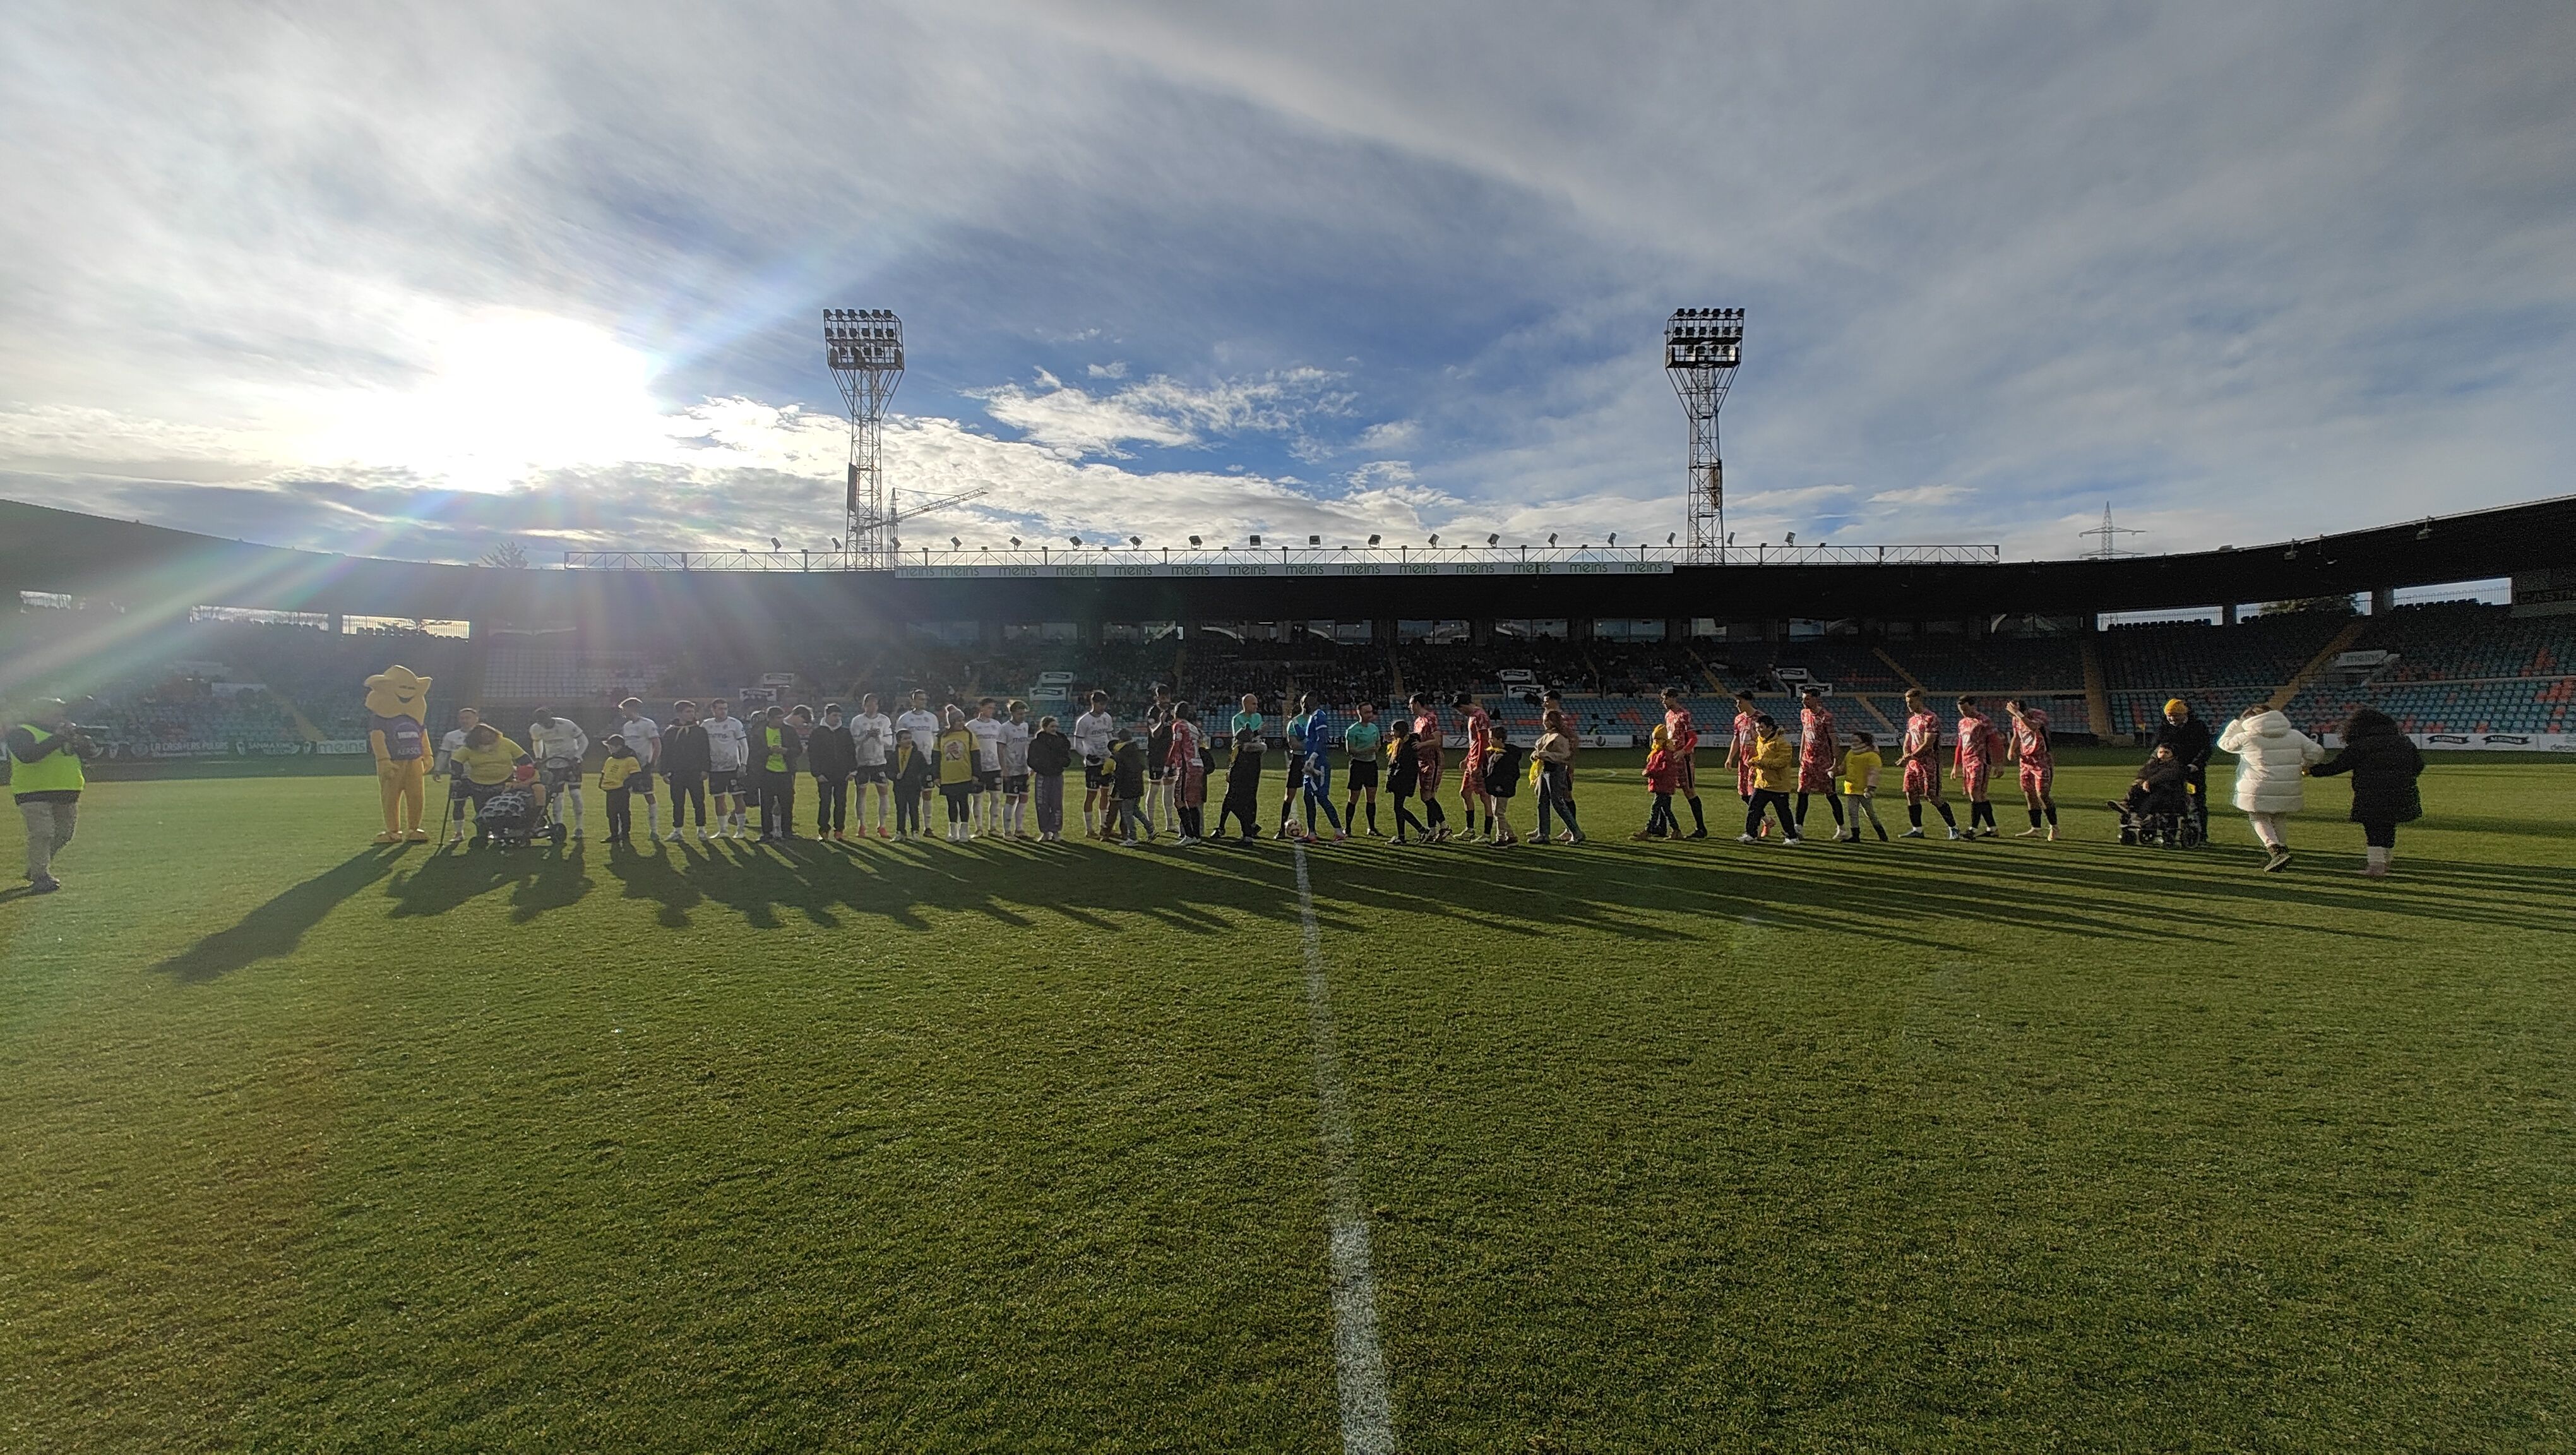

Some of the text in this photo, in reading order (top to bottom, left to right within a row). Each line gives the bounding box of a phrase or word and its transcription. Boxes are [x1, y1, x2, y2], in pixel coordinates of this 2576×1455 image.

[897, 567, 934, 577] meins
[941, 566, 979, 576] meins
[999, 566, 1037, 576] meins
[1056, 566, 1095, 576] meins
[1114, 565, 1152, 575] meins
[1171, 565, 1210, 575] meins
[1229, 565, 1267, 575] meins
[1285, 565, 1323, 575] meins
[1342, 565, 1380, 574] meins
[1399, 565, 1438, 574] meins
[1456, 564, 1494, 573] meins
[1570, 563, 1607, 573] meins
[1625, 563, 1663, 572] meins
[318, 741, 366, 753] meins
